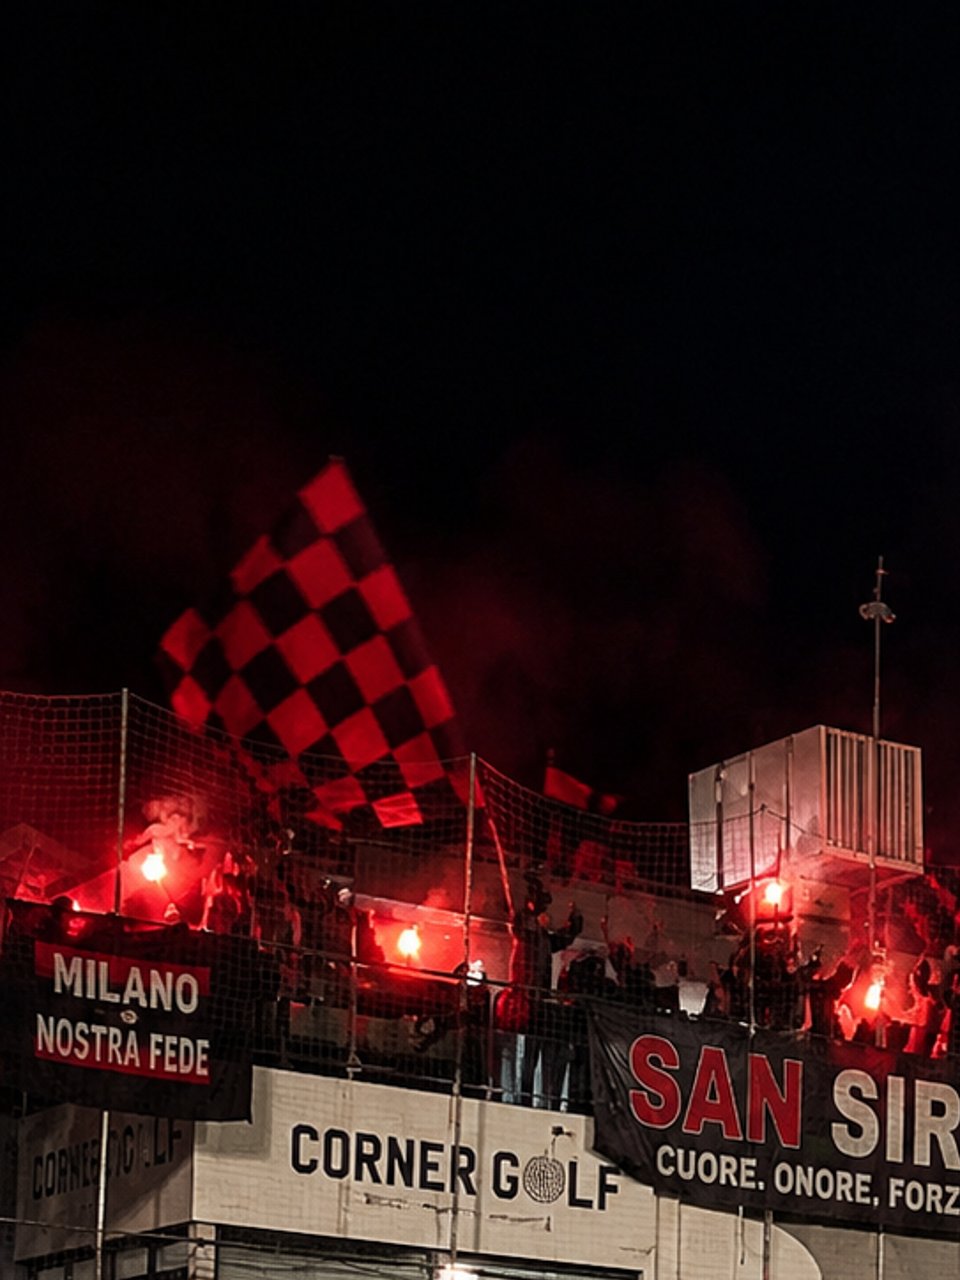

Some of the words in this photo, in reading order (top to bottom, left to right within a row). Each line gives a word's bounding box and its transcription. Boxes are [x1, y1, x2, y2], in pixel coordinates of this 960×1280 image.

[54, 952, 199, 1015] MILANO
[36, 1013, 141, 1068] NOSTRA
[150, 1033, 211, 1076] FEDE
[628, 1033, 804, 1149] SAN
[291, 1123, 477, 1196] CORNER
[656, 1144, 765, 1190] CUORE.
